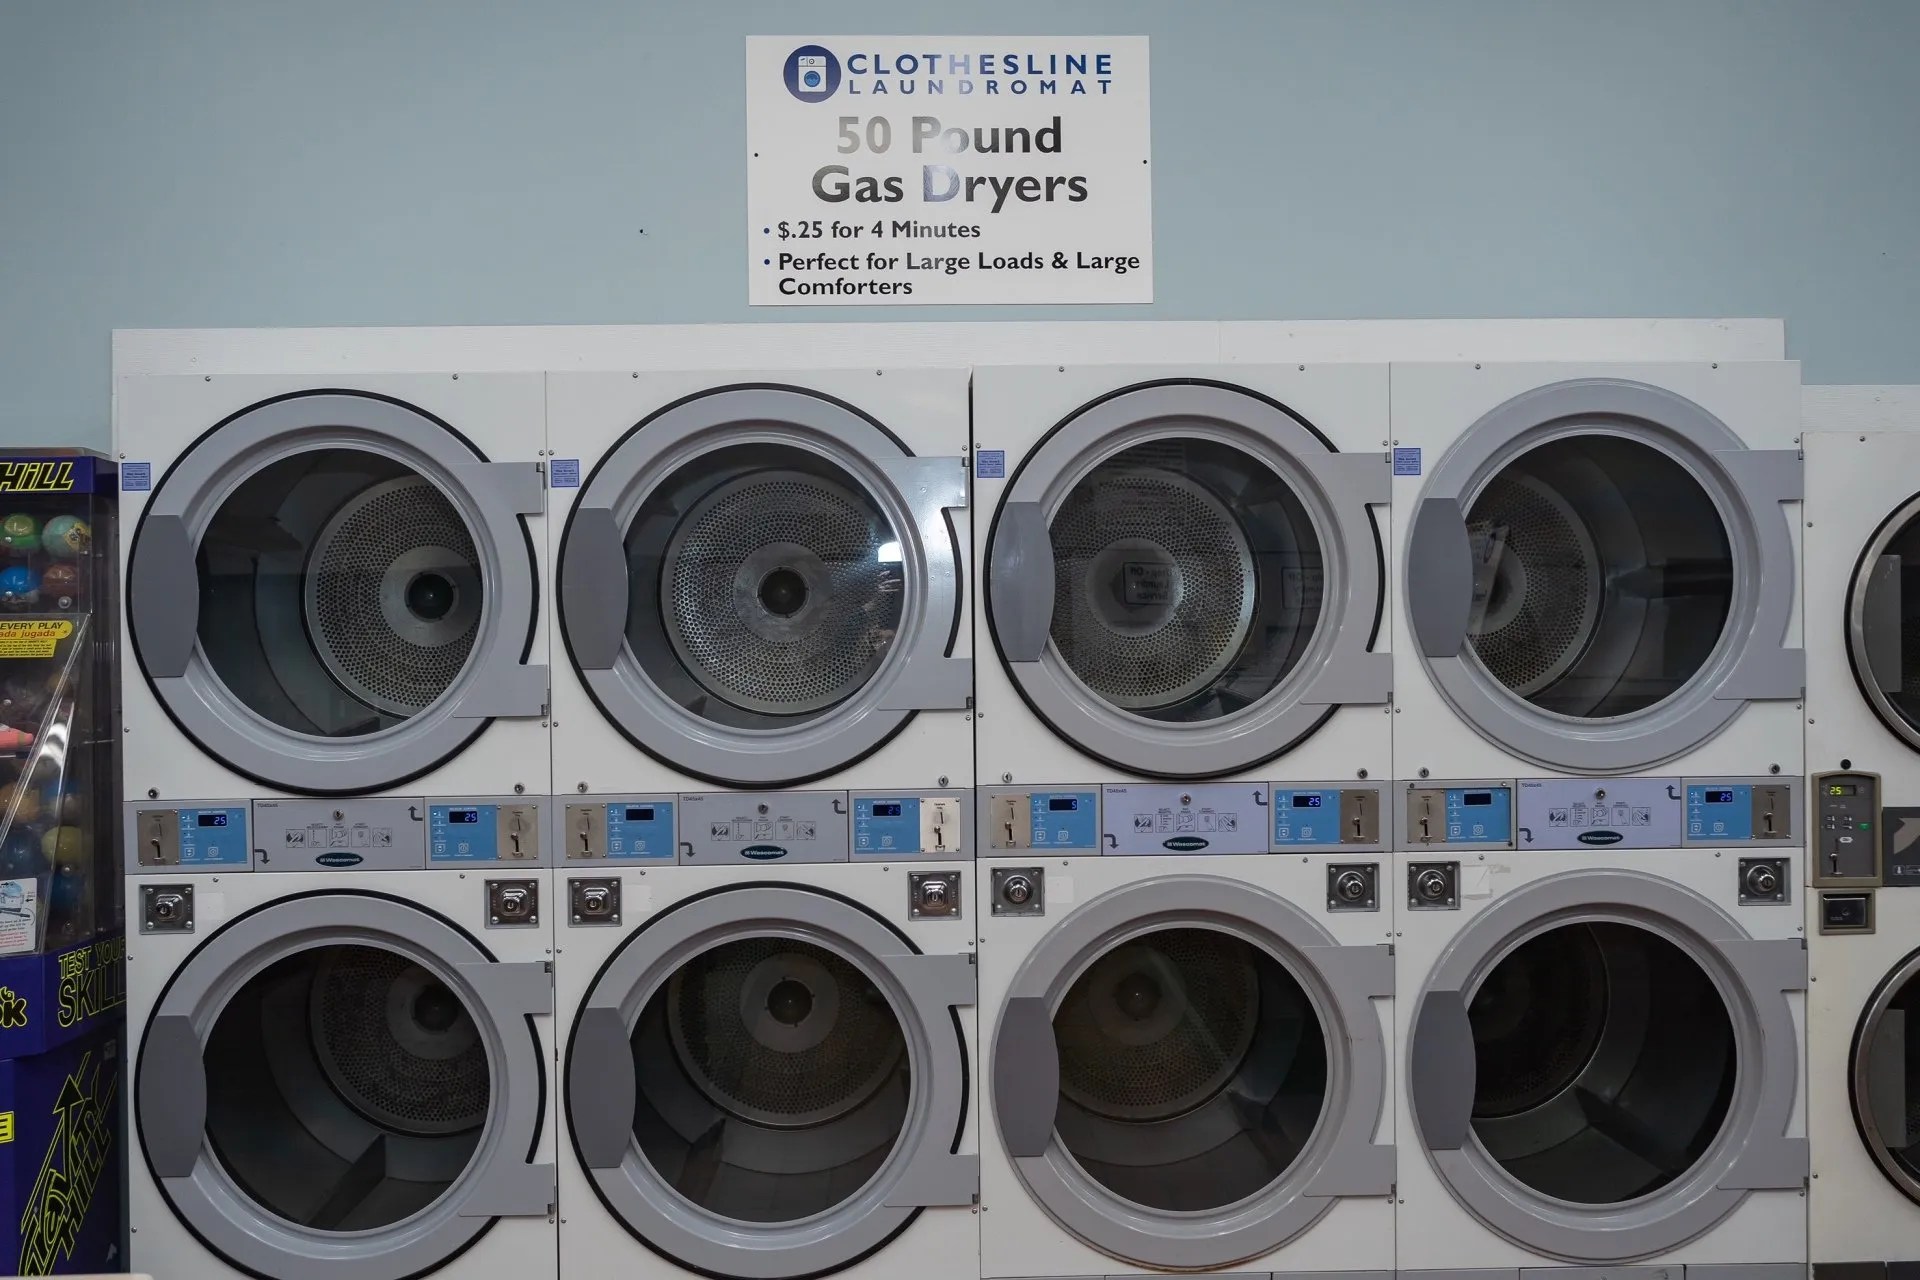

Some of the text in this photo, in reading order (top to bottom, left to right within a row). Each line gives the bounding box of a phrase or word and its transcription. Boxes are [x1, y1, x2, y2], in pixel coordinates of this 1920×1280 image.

[846, 53, 1112, 76] CLOTHESLINE
[848, 78, 1112, 96] LAUNDROMAT
[836, 114, 1063, 155] 50 Pound
[811, 164, 1089, 214] Gas Dryers
[777, 220, 981, 240] $.25 for 4 Minutes
[778, 252, 1141, 276] Perfect for Large Loads & Large
[778, 276, 913, 296] Comforters
[0, 622, 64, 630] EVERY PLAY
[21, 629, 56, 639] jugada
[1720, 792, 1732, 802] 25
[1829, 786, 1842, 795] 25
[1308, 797, 1320, 806] 25
[213, 815, 226, 826] 25
[464, 812, 477, 822] 25
[58, 946, 92, 980] TEST
